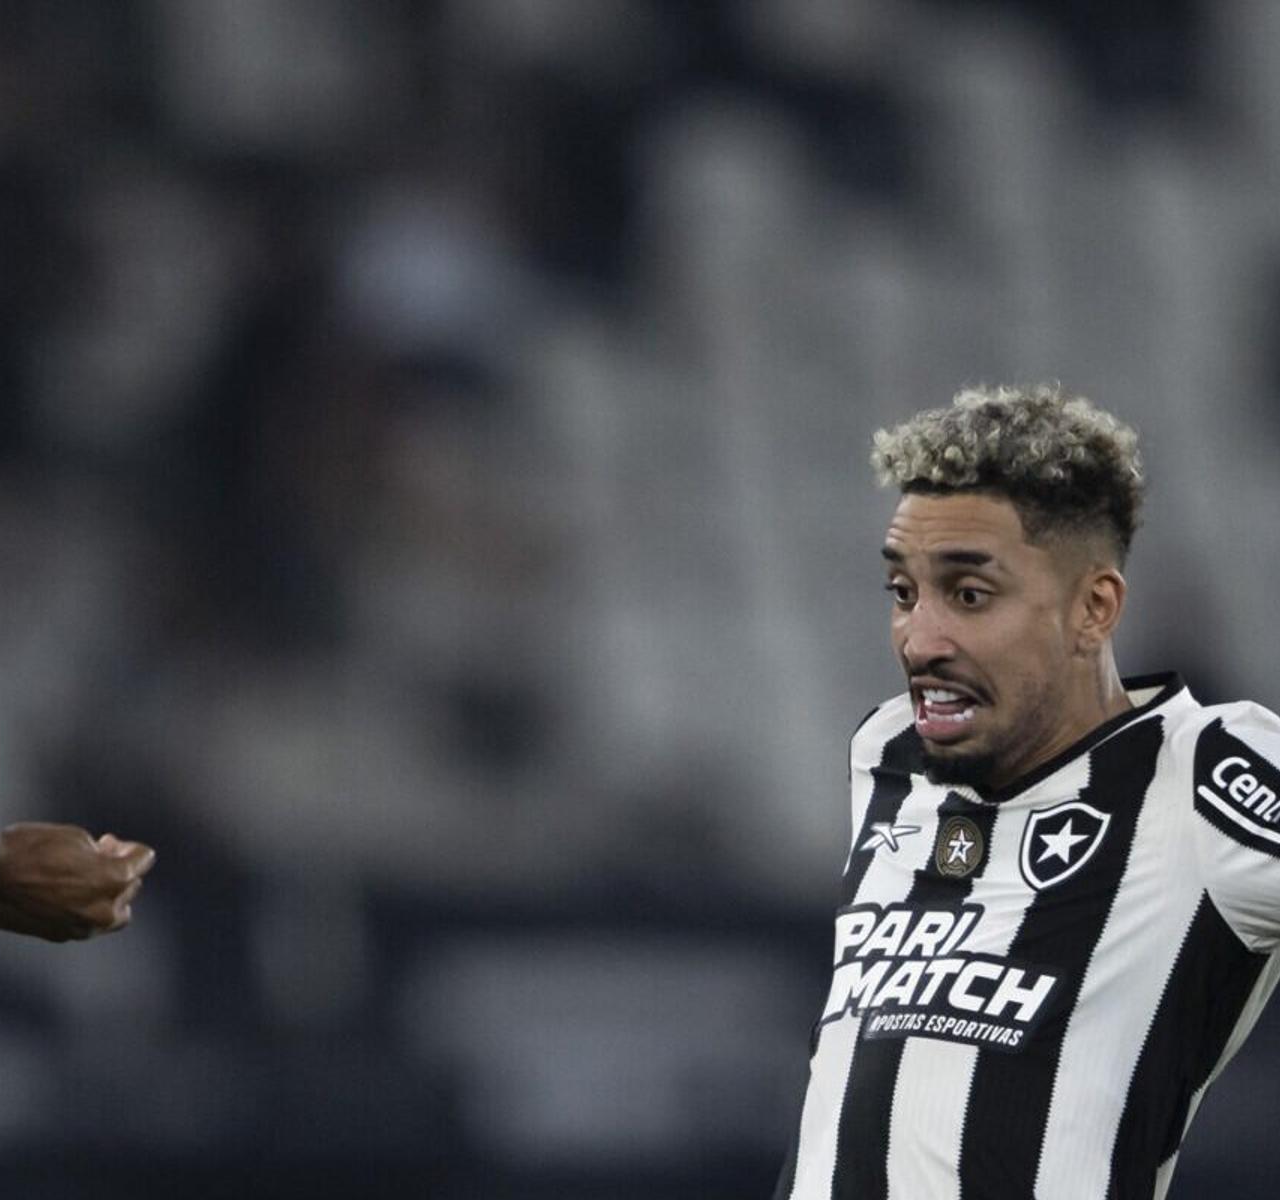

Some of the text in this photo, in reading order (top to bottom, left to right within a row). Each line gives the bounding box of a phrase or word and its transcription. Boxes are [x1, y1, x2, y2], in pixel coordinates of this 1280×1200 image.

[833, 909, 978, 968] PARI
[821, 958, 1058, 1023] MATCH
[923, 1014, 1024, 1047] ESPORTIVAS
